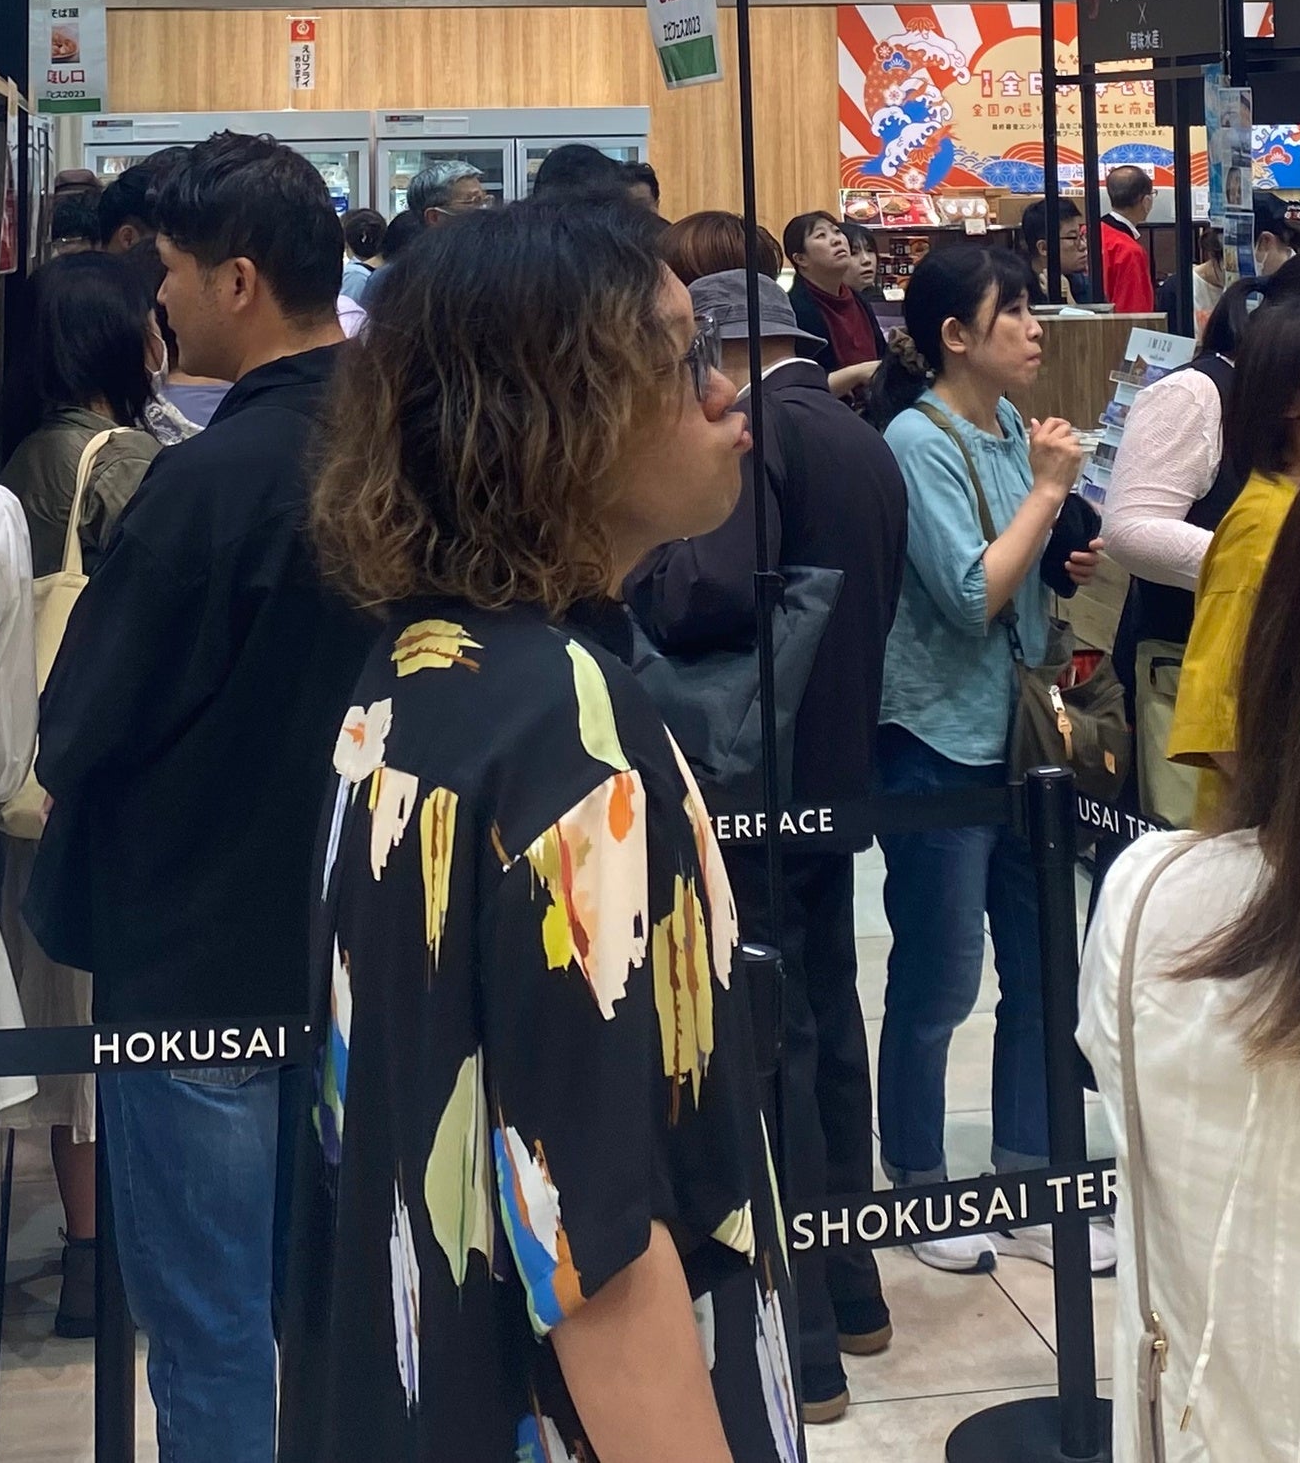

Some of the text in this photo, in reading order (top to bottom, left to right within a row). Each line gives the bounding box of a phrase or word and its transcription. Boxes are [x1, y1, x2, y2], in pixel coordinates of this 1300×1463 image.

[663, 15, 701, 41] エビフェス2023
[709, 808, 835, 840] ERRACE
[1078, 796, 1120, 834] USAI
[94, 1026, 286, 1065] HOKUSAI
[791, 1183, 1028, 1250] SHOKUSAI
